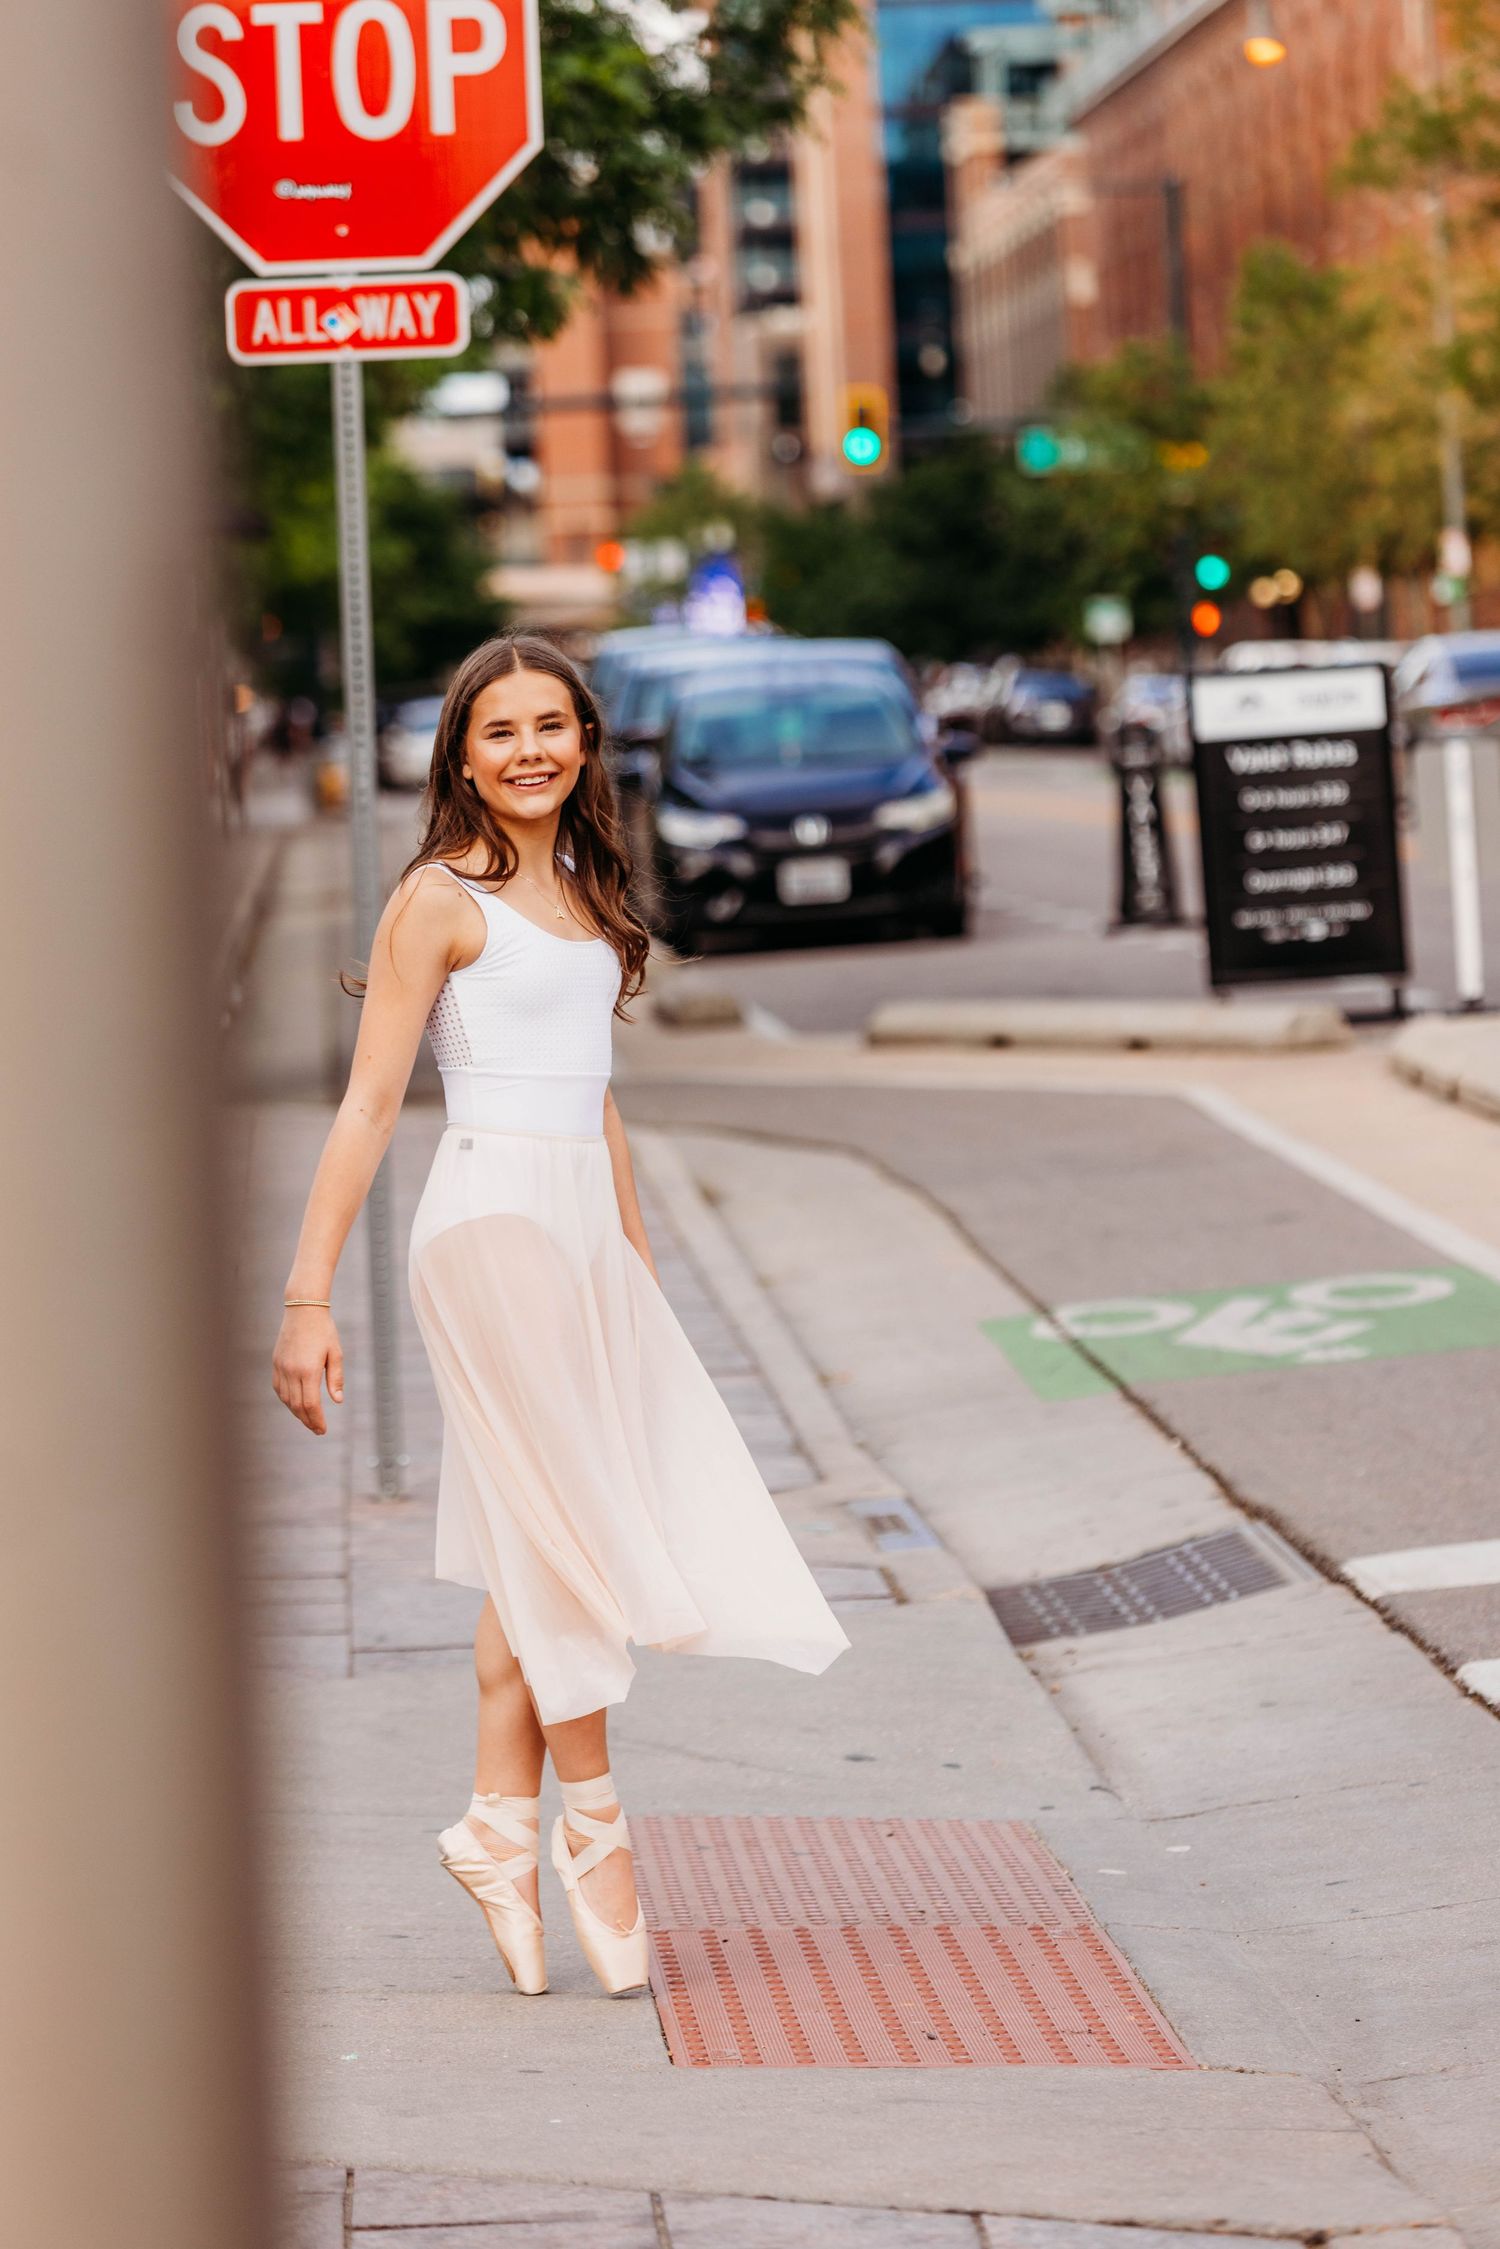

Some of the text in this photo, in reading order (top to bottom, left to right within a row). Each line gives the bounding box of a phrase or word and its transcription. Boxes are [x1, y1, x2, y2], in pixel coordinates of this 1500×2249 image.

[173, 0, 507, 146] STOP
[252, 291, 442, 346] ALL WAY
